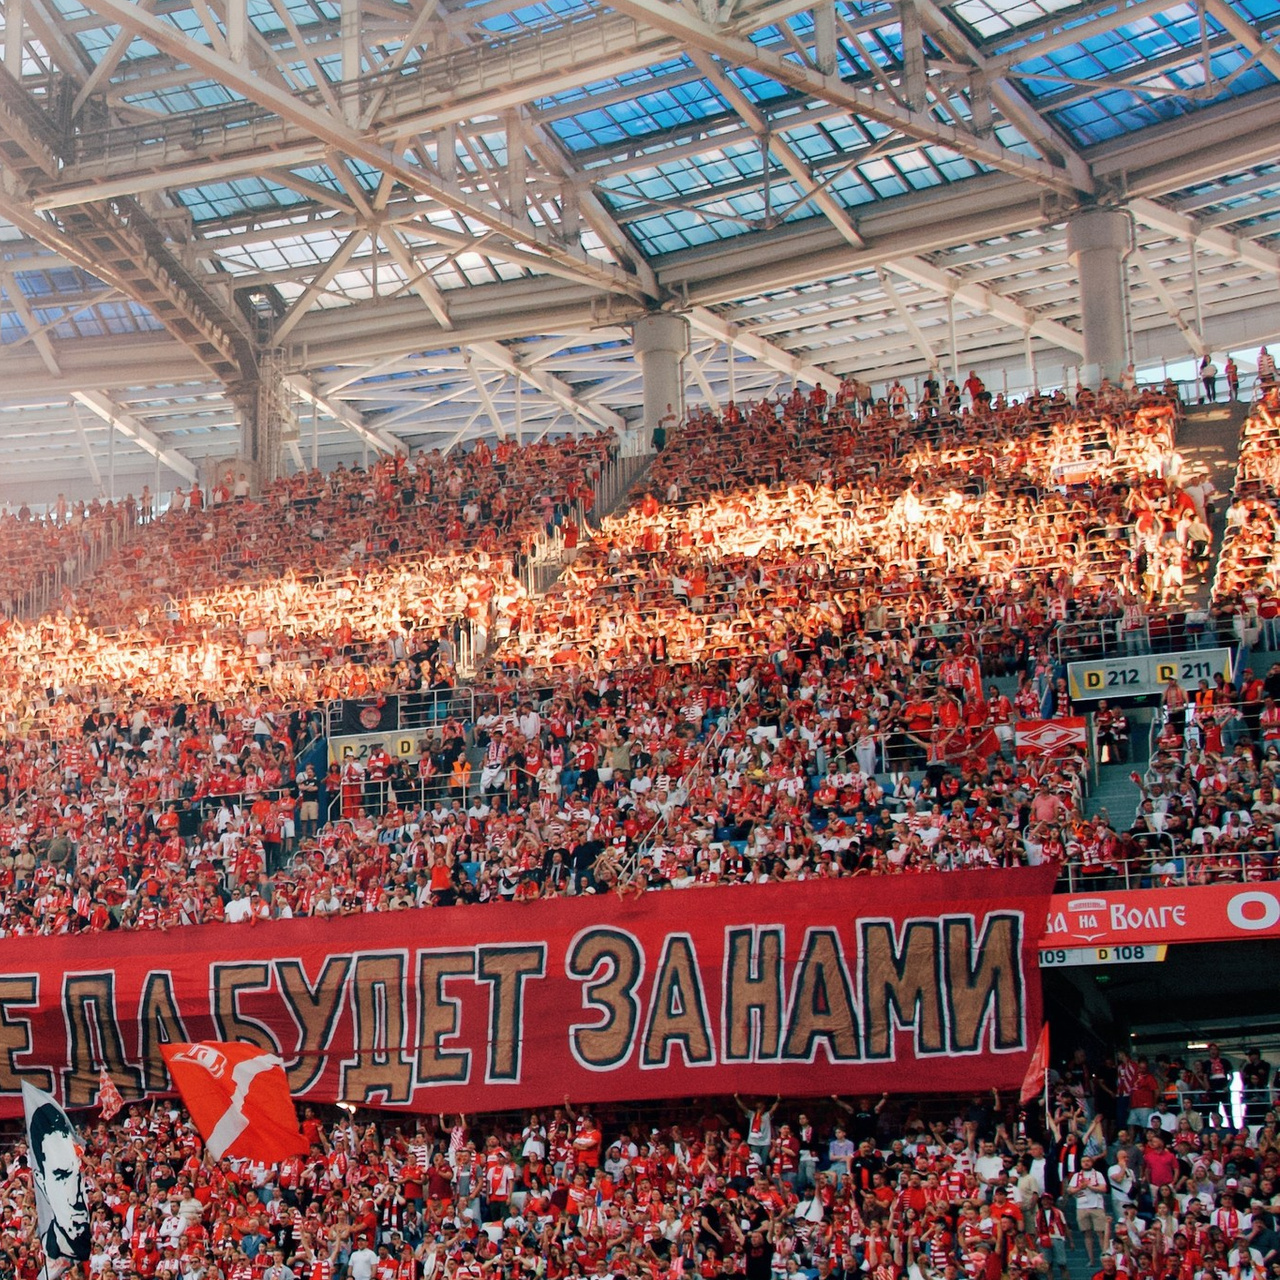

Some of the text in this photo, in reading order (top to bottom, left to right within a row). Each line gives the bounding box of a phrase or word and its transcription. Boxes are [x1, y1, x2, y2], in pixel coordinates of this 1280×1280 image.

[1087, 662, 1211, 687] D 212 D 211
[401, 740, 410, 753] D
[1038, 946, 1145, 964] 109 D 108
[209, 941, 548, 1106] БУДЕТ
[565, 924, 716, 1072] ЗА
[721, 910, 1027, 1065] НАМИ
